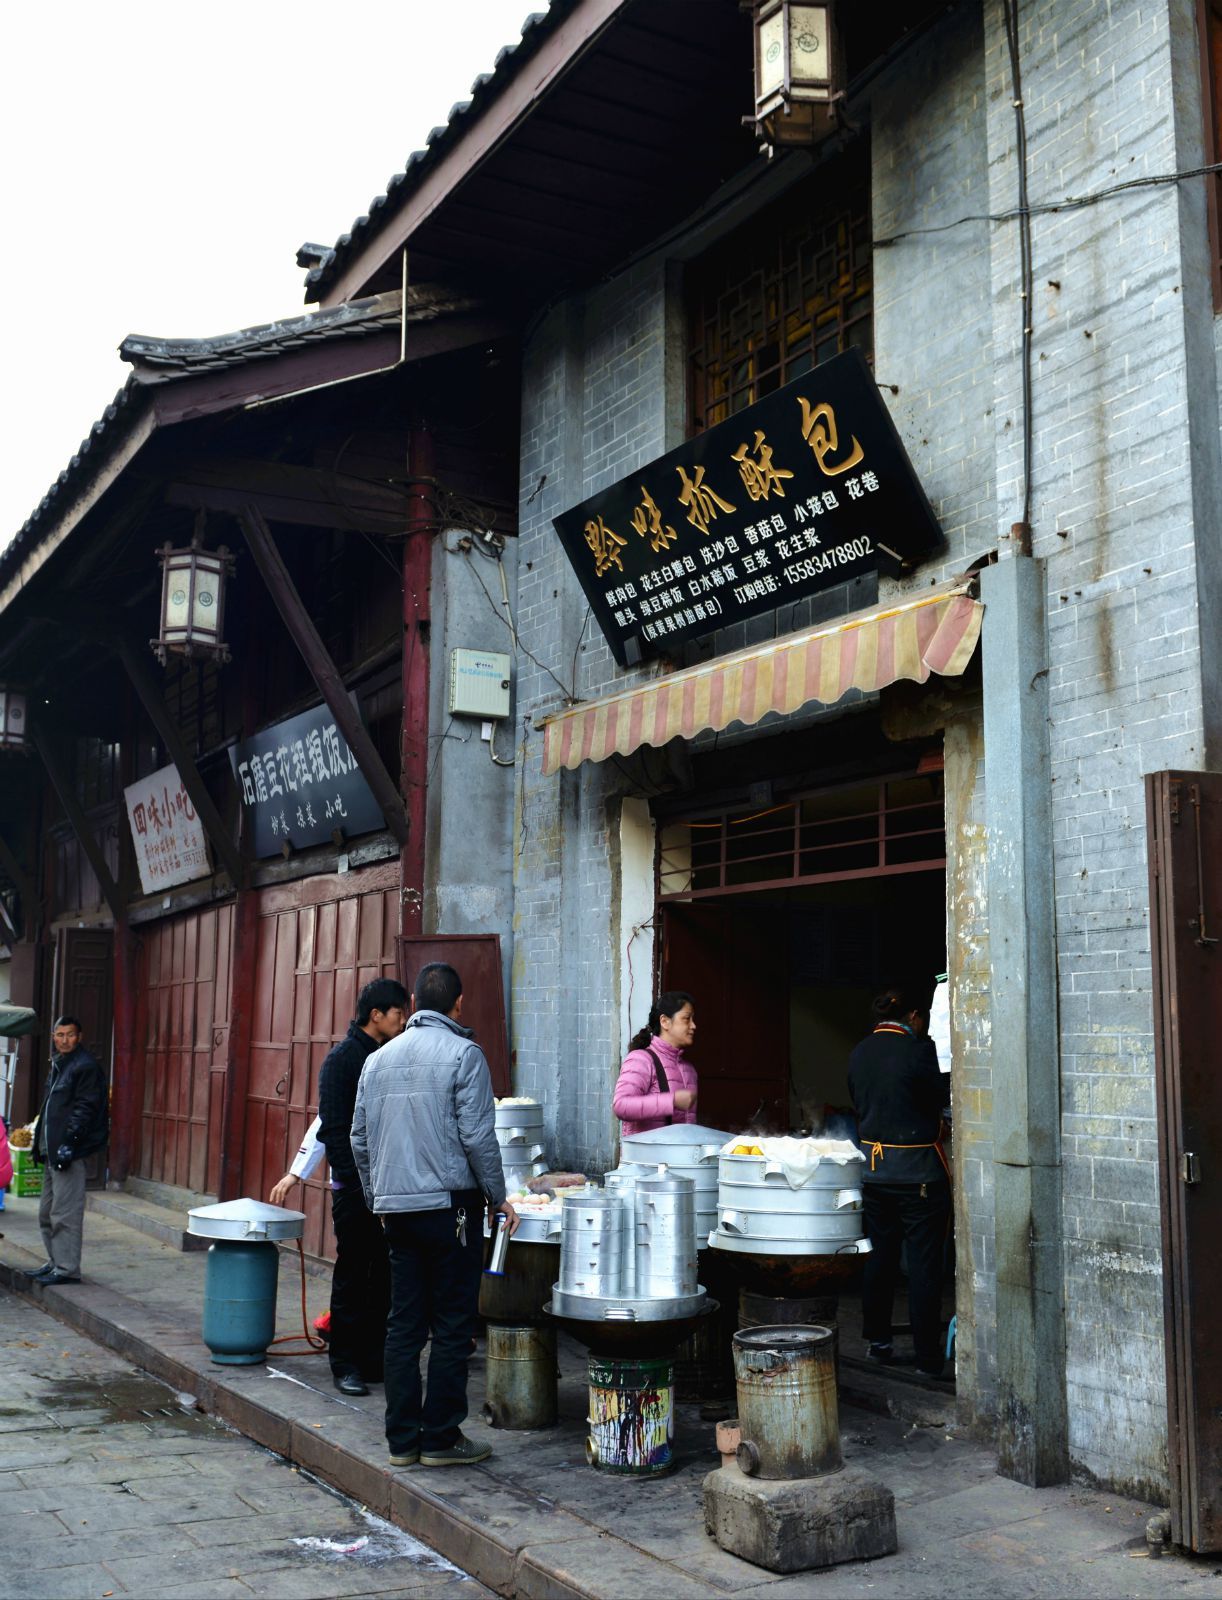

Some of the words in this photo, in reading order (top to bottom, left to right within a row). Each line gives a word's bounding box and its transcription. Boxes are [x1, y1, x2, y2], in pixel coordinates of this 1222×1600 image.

[584, 397, 865, 578] 黔味抓酥包
[605, 582, 638, 608] 鲜肉包
[639, 555, 697, 593] 花生白糖包
[699, 535, 740, 566] 洗沙包
[743, 513, 788, 545] 香菇包
[793, 490, 840, 523] 小笼包
[844, 470, 880, 501] 花卷
[614, 606, 638, 627] 馒头
[639, 585, 686, 617] 绿豆稀饭
[687, 562, 739, 597] 白水稀饭
[741, 548, 772, 574] 豆浆
[774, 527, 822, 560] 花生浆
[783, 535, 875, 585] 15583478802
[325, 793, 348, 819] 小吃
